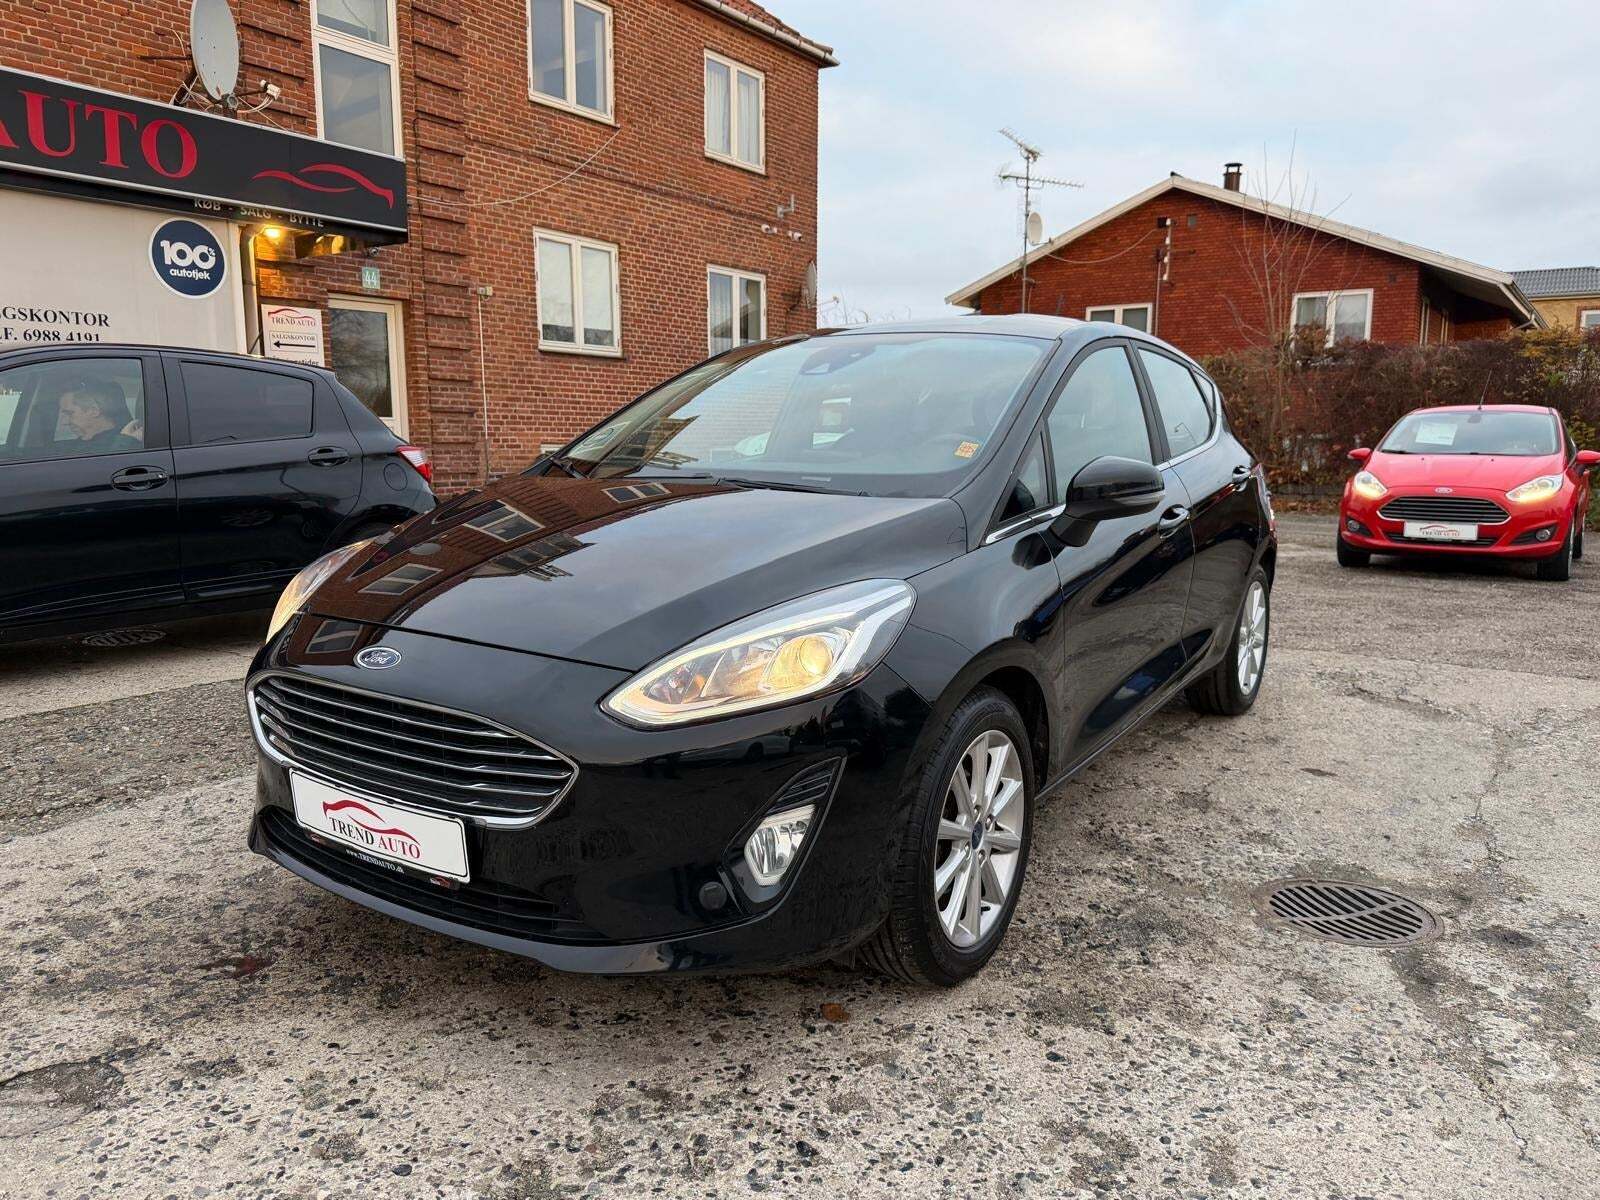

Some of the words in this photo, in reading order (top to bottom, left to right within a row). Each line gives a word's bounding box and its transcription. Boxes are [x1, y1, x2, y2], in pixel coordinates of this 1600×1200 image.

[240, 206, 272, 220] SALG
[289, 214, 325, 228] BYTTE
[169, 268, 211, 281] autotjek
[365, 271, 378, 286] 44
[0, 306, 110, 328] GSKONTOR
[271, 316, 296, 326] TREND
[297, 319, 316, 327] AUTO
[0, 327, 18, 341] F.
[23, 328, 61, 342] 6988
[66, 331, 100, 342] 4191
[271, 332, 316, 341] SALGSKONTOR
[363, 650, 391, 665] Ford
[328, 816, 375, 846] TREND
[378, 835, 421, 859] AUTO
